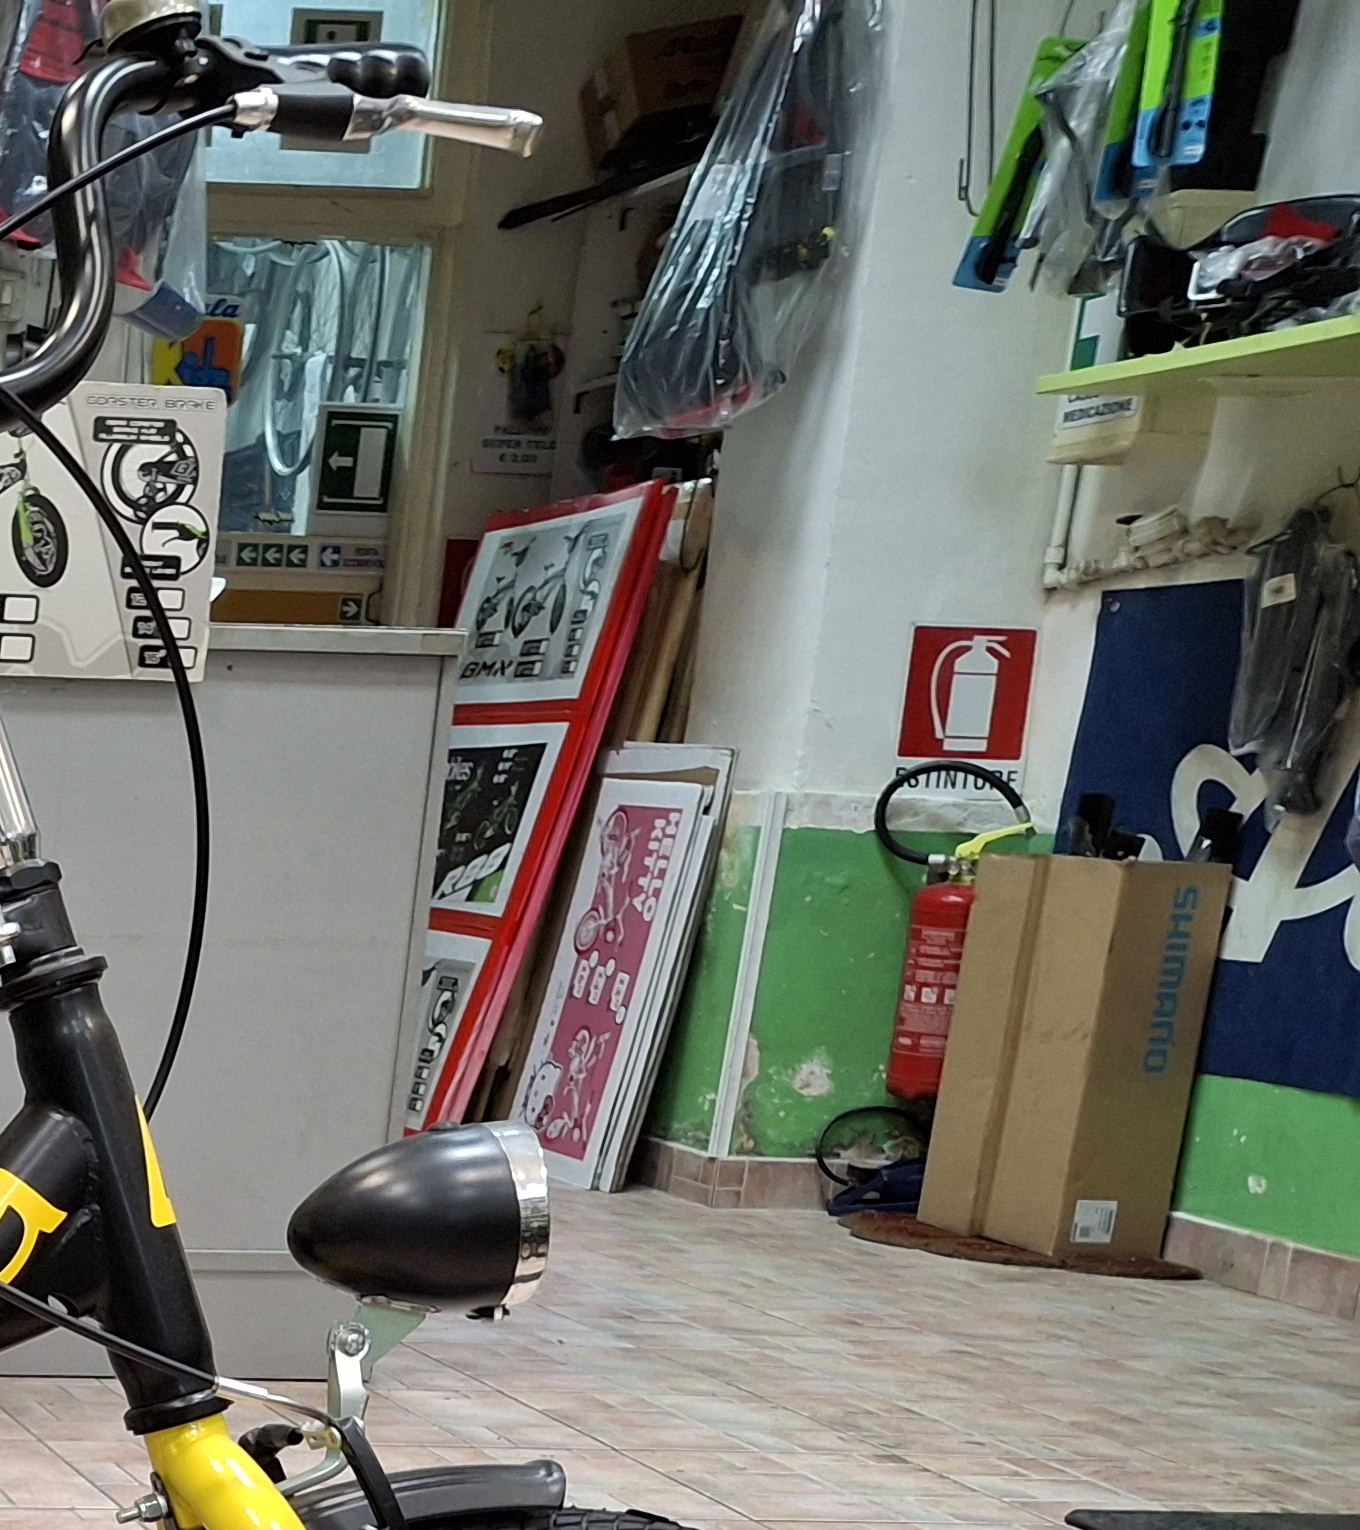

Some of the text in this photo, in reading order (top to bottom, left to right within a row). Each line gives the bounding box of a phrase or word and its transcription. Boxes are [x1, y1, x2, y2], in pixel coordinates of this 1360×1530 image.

[164, 399, 217, 411] BRAKE
[631, 818, 667, 913] KITTY
[642, 812, 681, 923] HELLO
[1142, 885, 1202, 1075] SHIMANO
